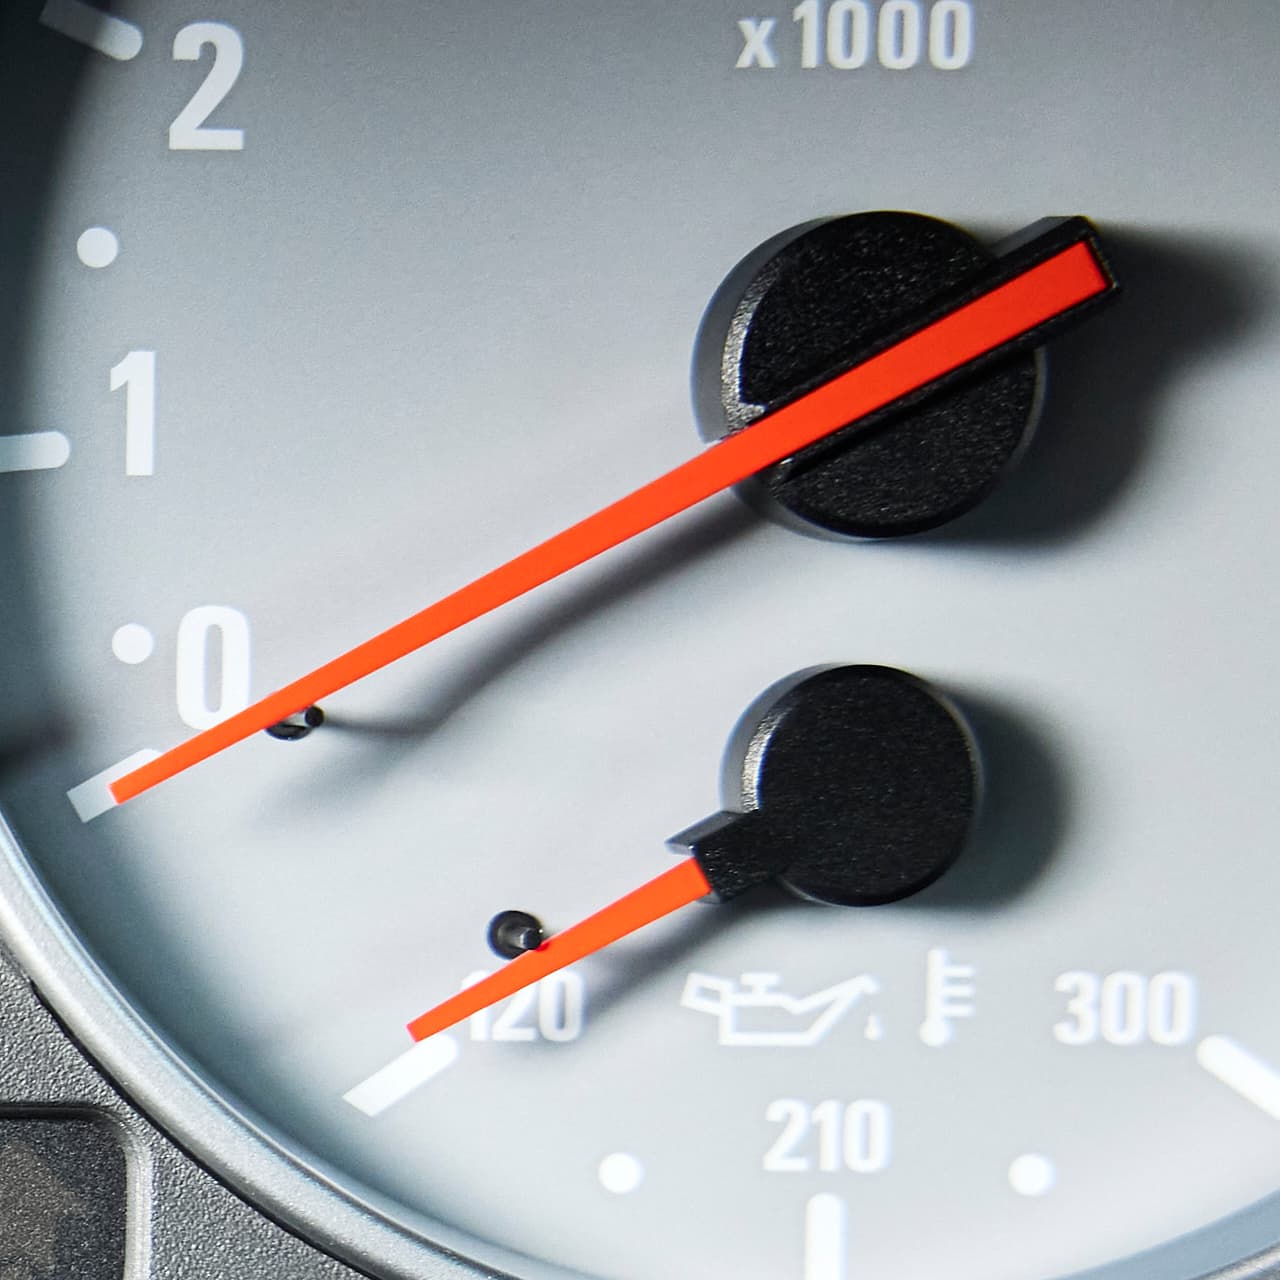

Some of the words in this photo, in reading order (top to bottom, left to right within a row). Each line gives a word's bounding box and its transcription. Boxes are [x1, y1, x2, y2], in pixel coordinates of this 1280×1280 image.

[168, 22, 245, 150] 2
[109, 350, 157, 476] 1
[176, 604, 250, 731] 0
[1053, 971, 1197, 1046] 300
[764, 1099, 892, 1172] 210
